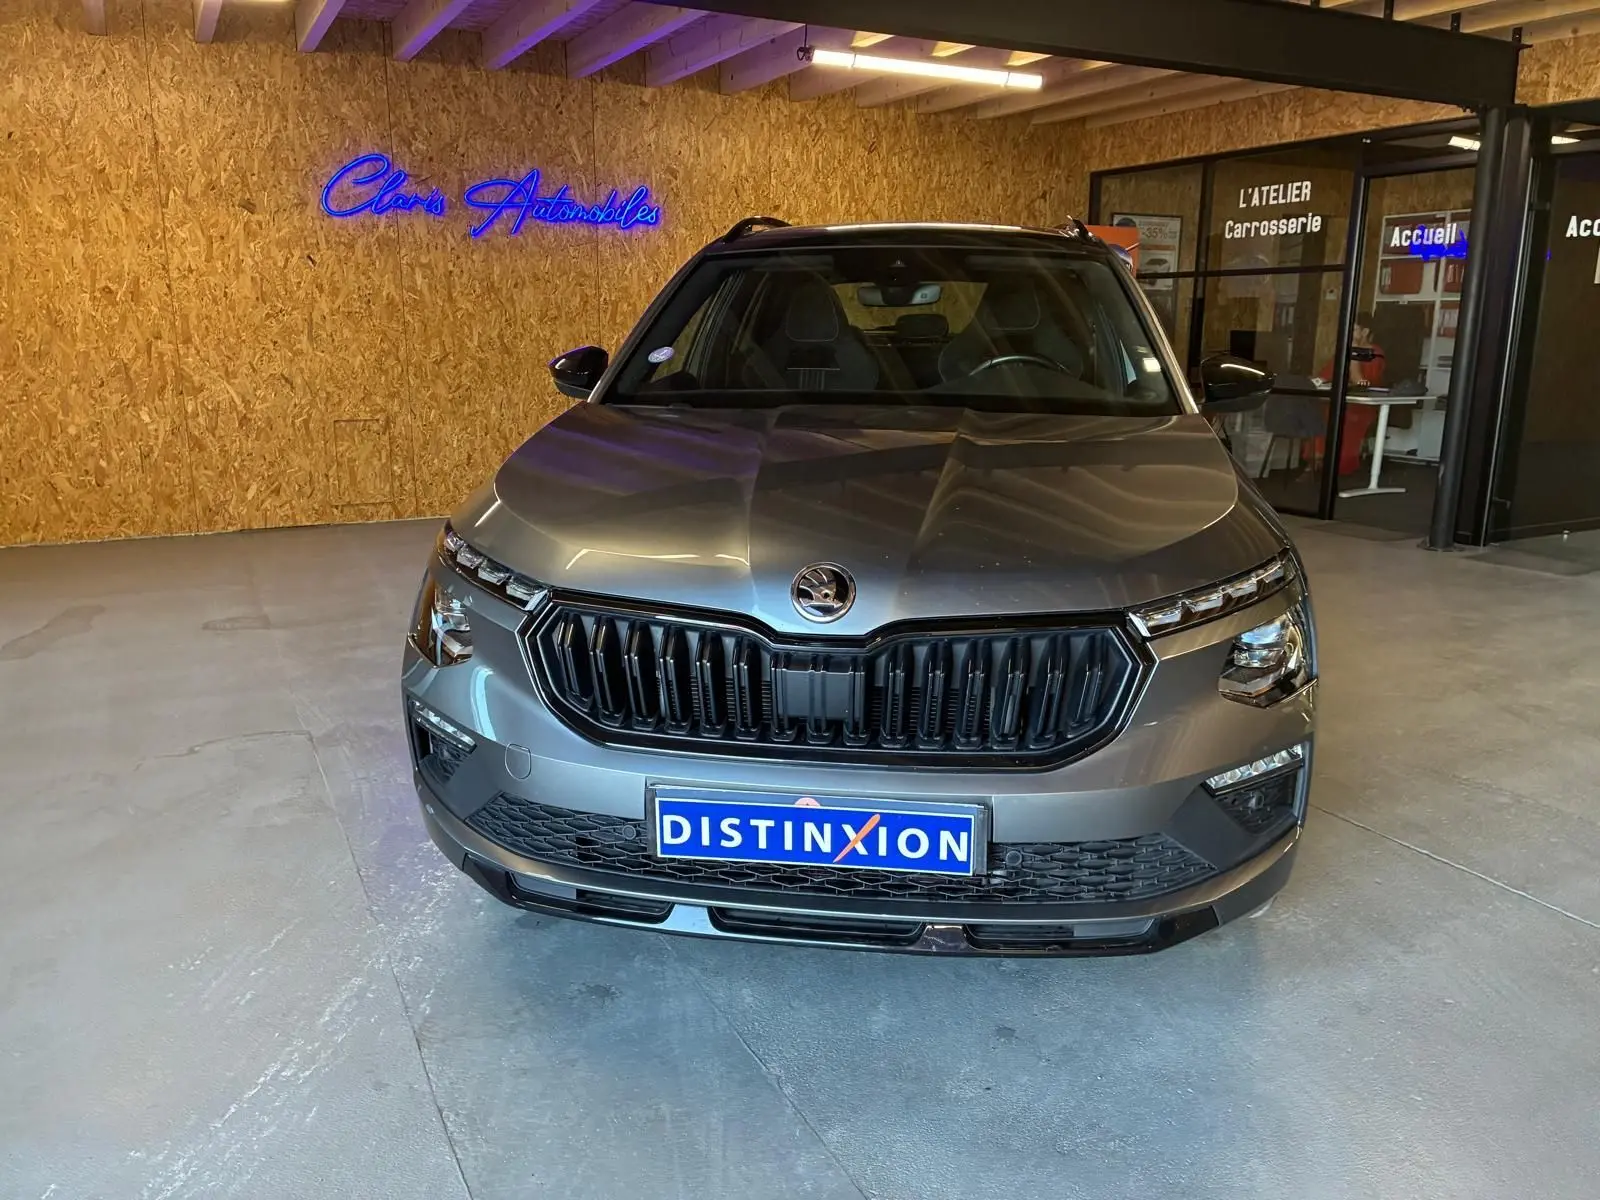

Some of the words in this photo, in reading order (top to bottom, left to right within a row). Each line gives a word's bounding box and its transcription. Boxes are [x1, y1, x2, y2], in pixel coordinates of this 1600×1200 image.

[464, 168, 661, 238] Automobiles
[1239, 181, 1312, 208] L'ATELIER
[1225, 212, 1322, 239] Carrosserie
[1390, 223, 1457, 247] Accueil
[662, 813, 969, 863] DISTINXION
